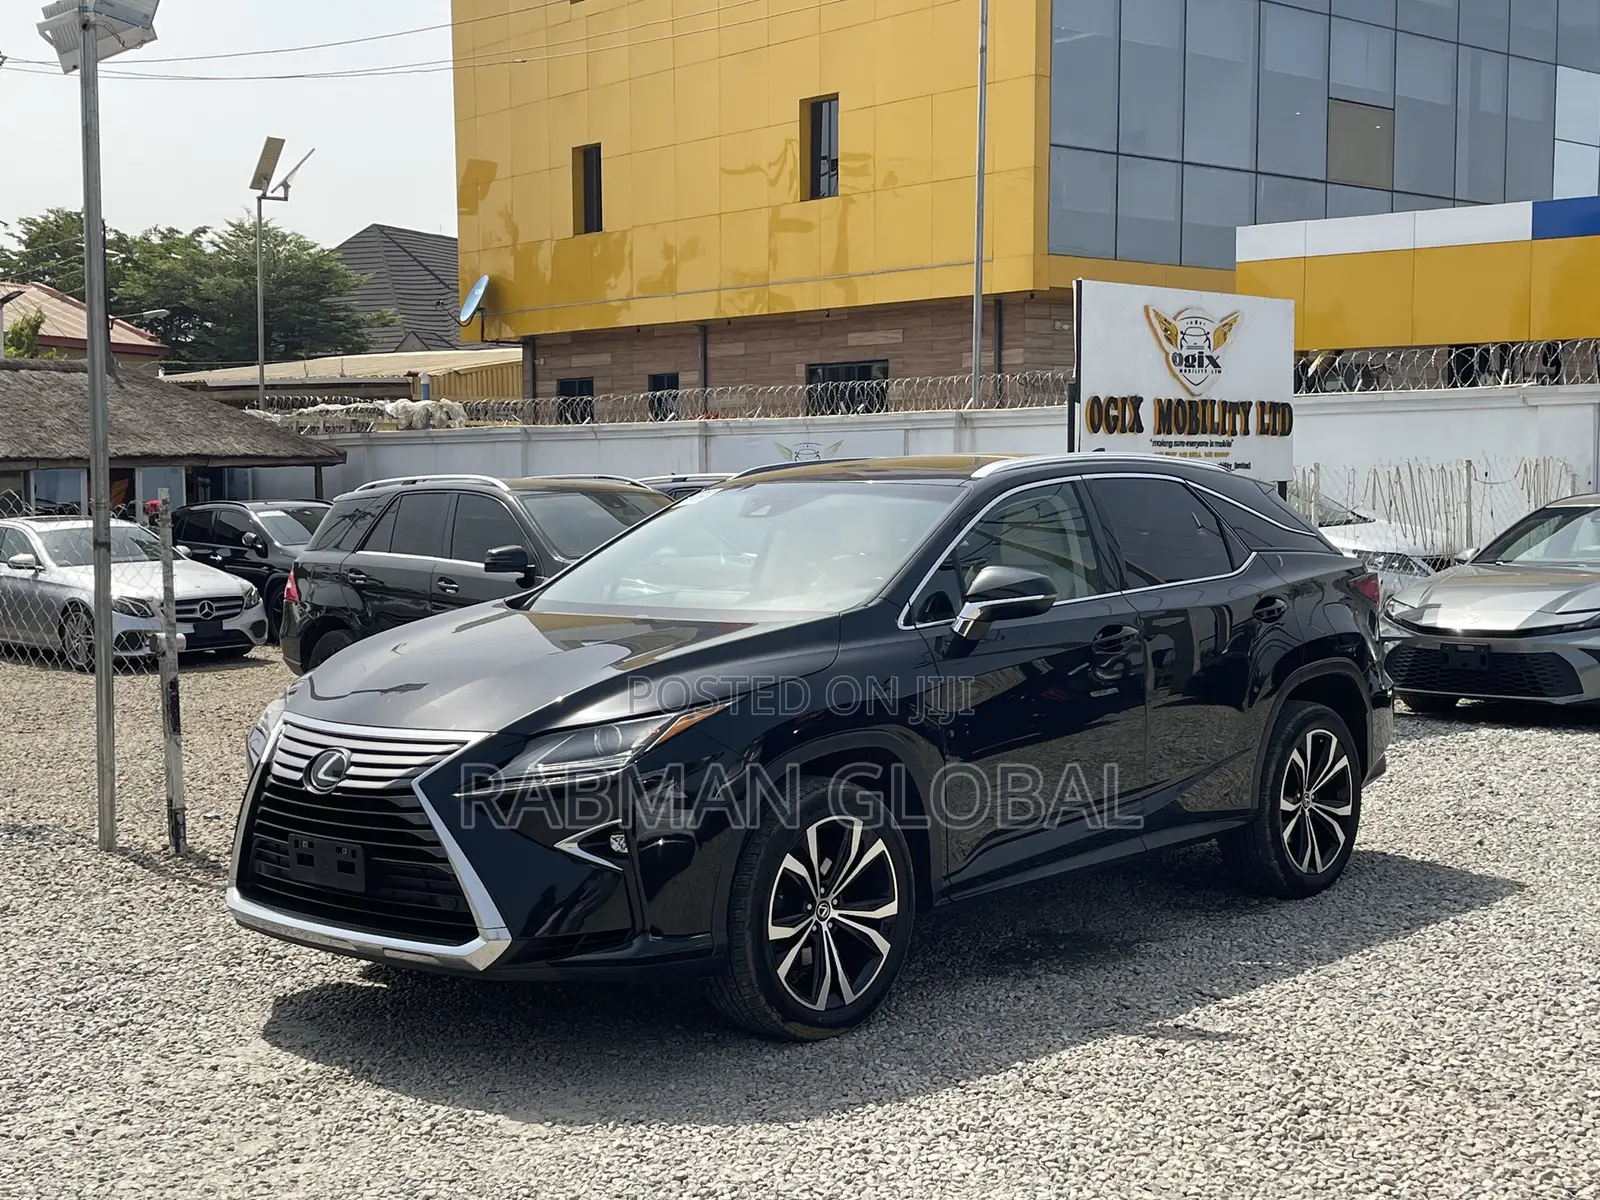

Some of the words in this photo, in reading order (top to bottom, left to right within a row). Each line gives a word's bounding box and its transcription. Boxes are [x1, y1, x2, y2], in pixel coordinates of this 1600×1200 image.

[1086, 395, 1144, 434] OGIX
[1153, 398, 1253, 436] MOBILITY
[1256, 400, 1293, 436] LTD
[1186, 440, 1209, 449] everyone
